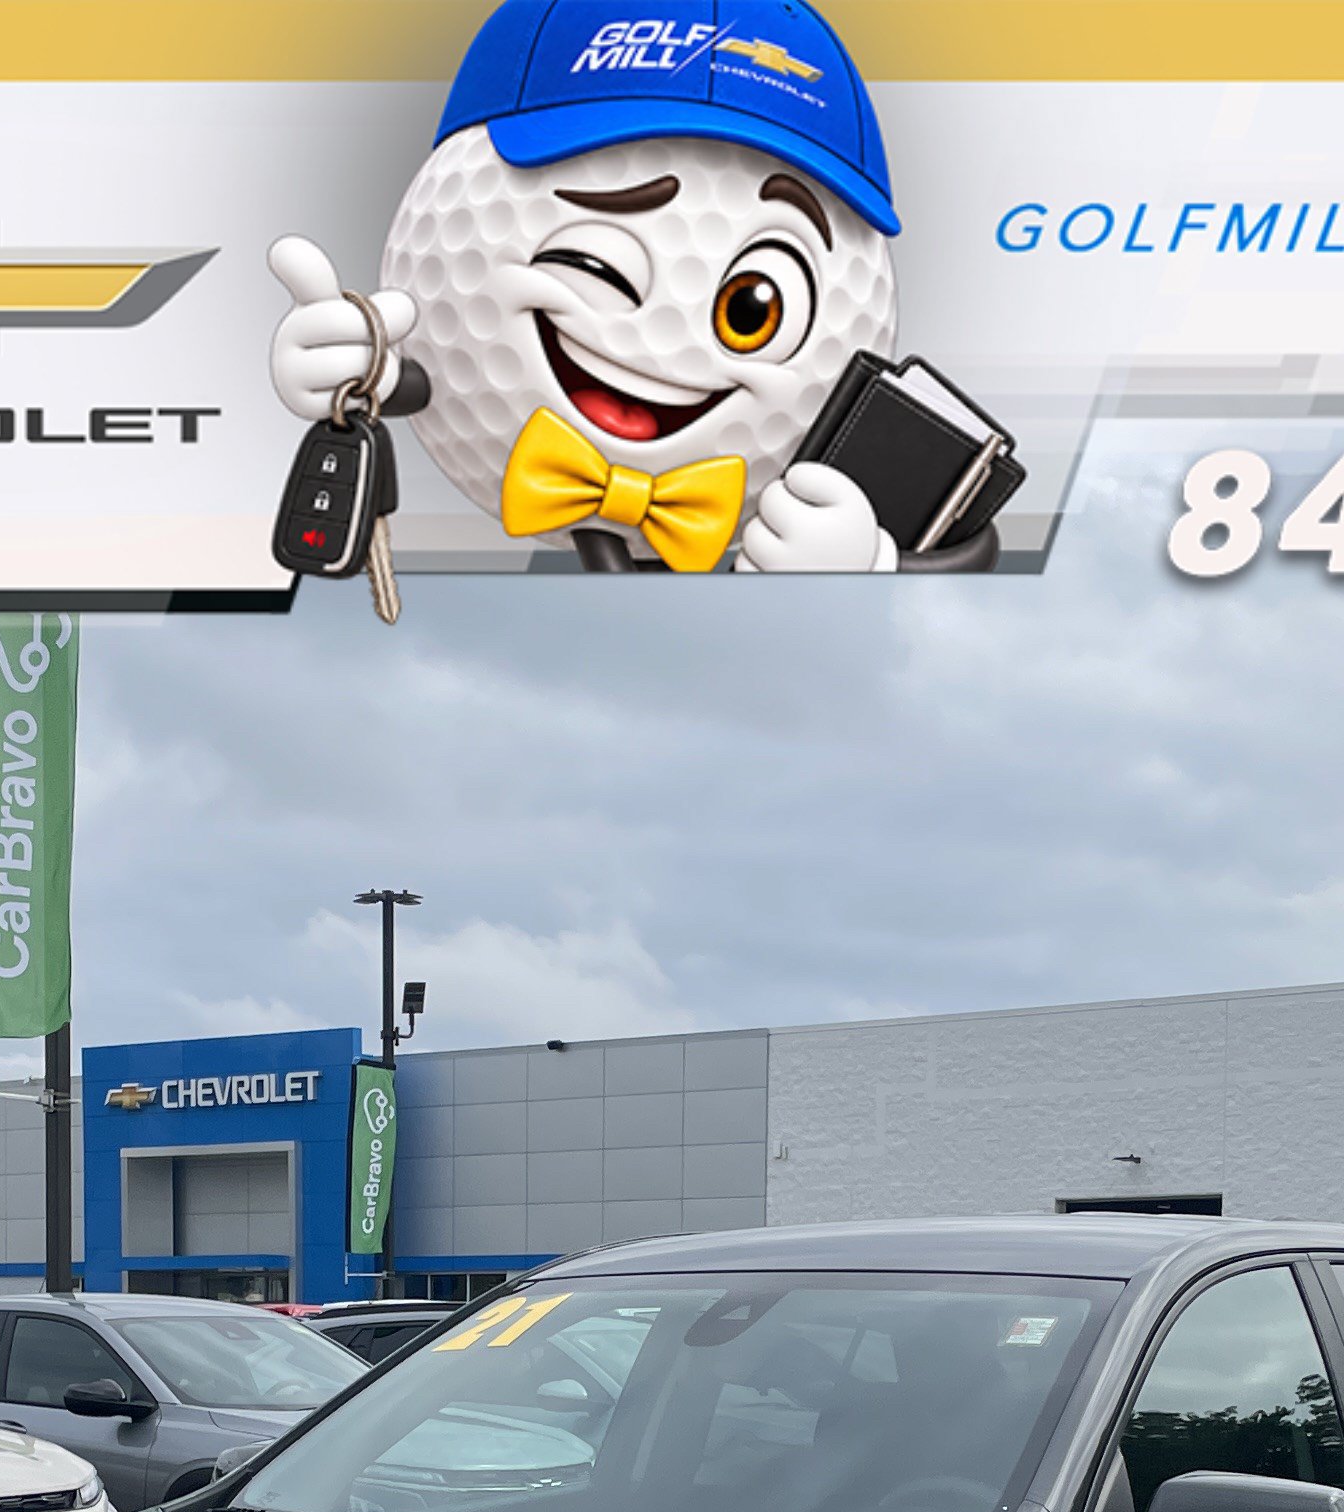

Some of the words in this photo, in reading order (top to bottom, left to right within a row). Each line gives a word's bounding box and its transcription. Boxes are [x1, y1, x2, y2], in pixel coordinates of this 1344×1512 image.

[161, 1070, 320, 1109] CHEVROLET
[361, 1138, 383, 1234] CarBravo
[431, 1291, 575, 1352] 21
